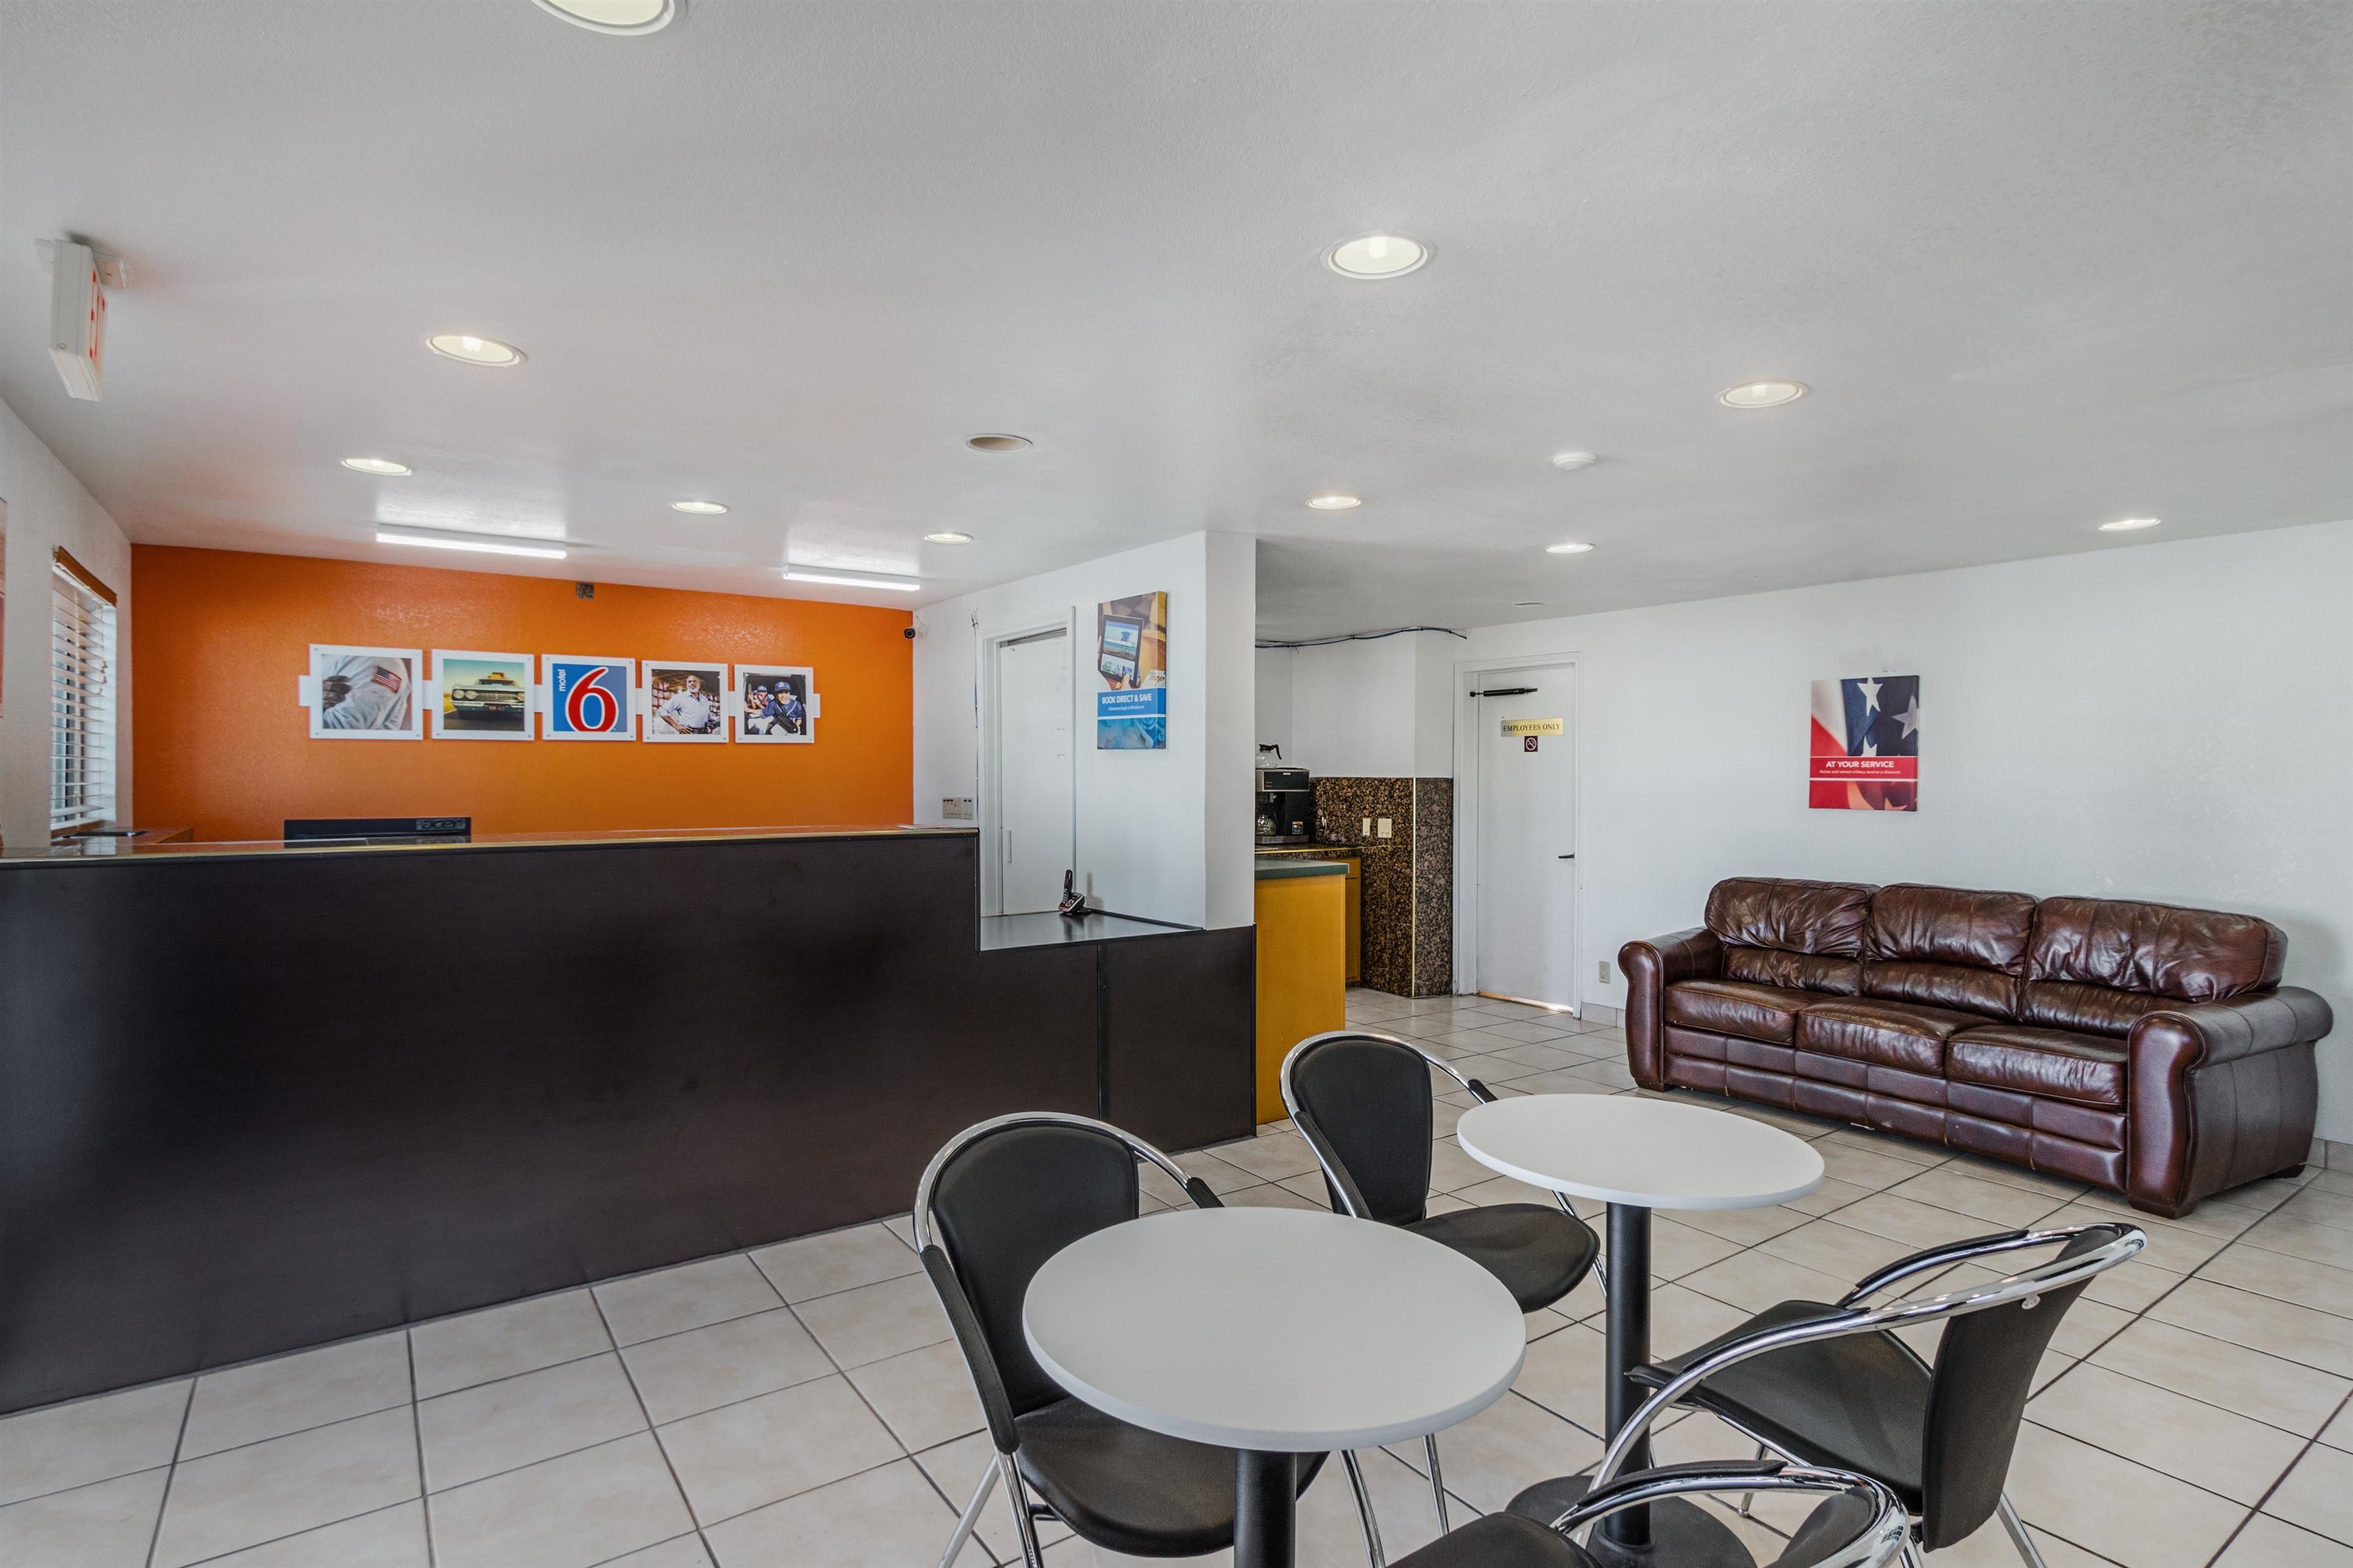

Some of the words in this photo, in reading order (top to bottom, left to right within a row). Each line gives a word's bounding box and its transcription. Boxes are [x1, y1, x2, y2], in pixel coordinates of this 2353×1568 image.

[557, 669, 566, 692] motel
[565, 666, 619, 732] 6
[1116, 694, 1134, 703] DIRECT
[1134, 694, 1139, 702] &
[1139, 693, 1152, 702] SAVE
